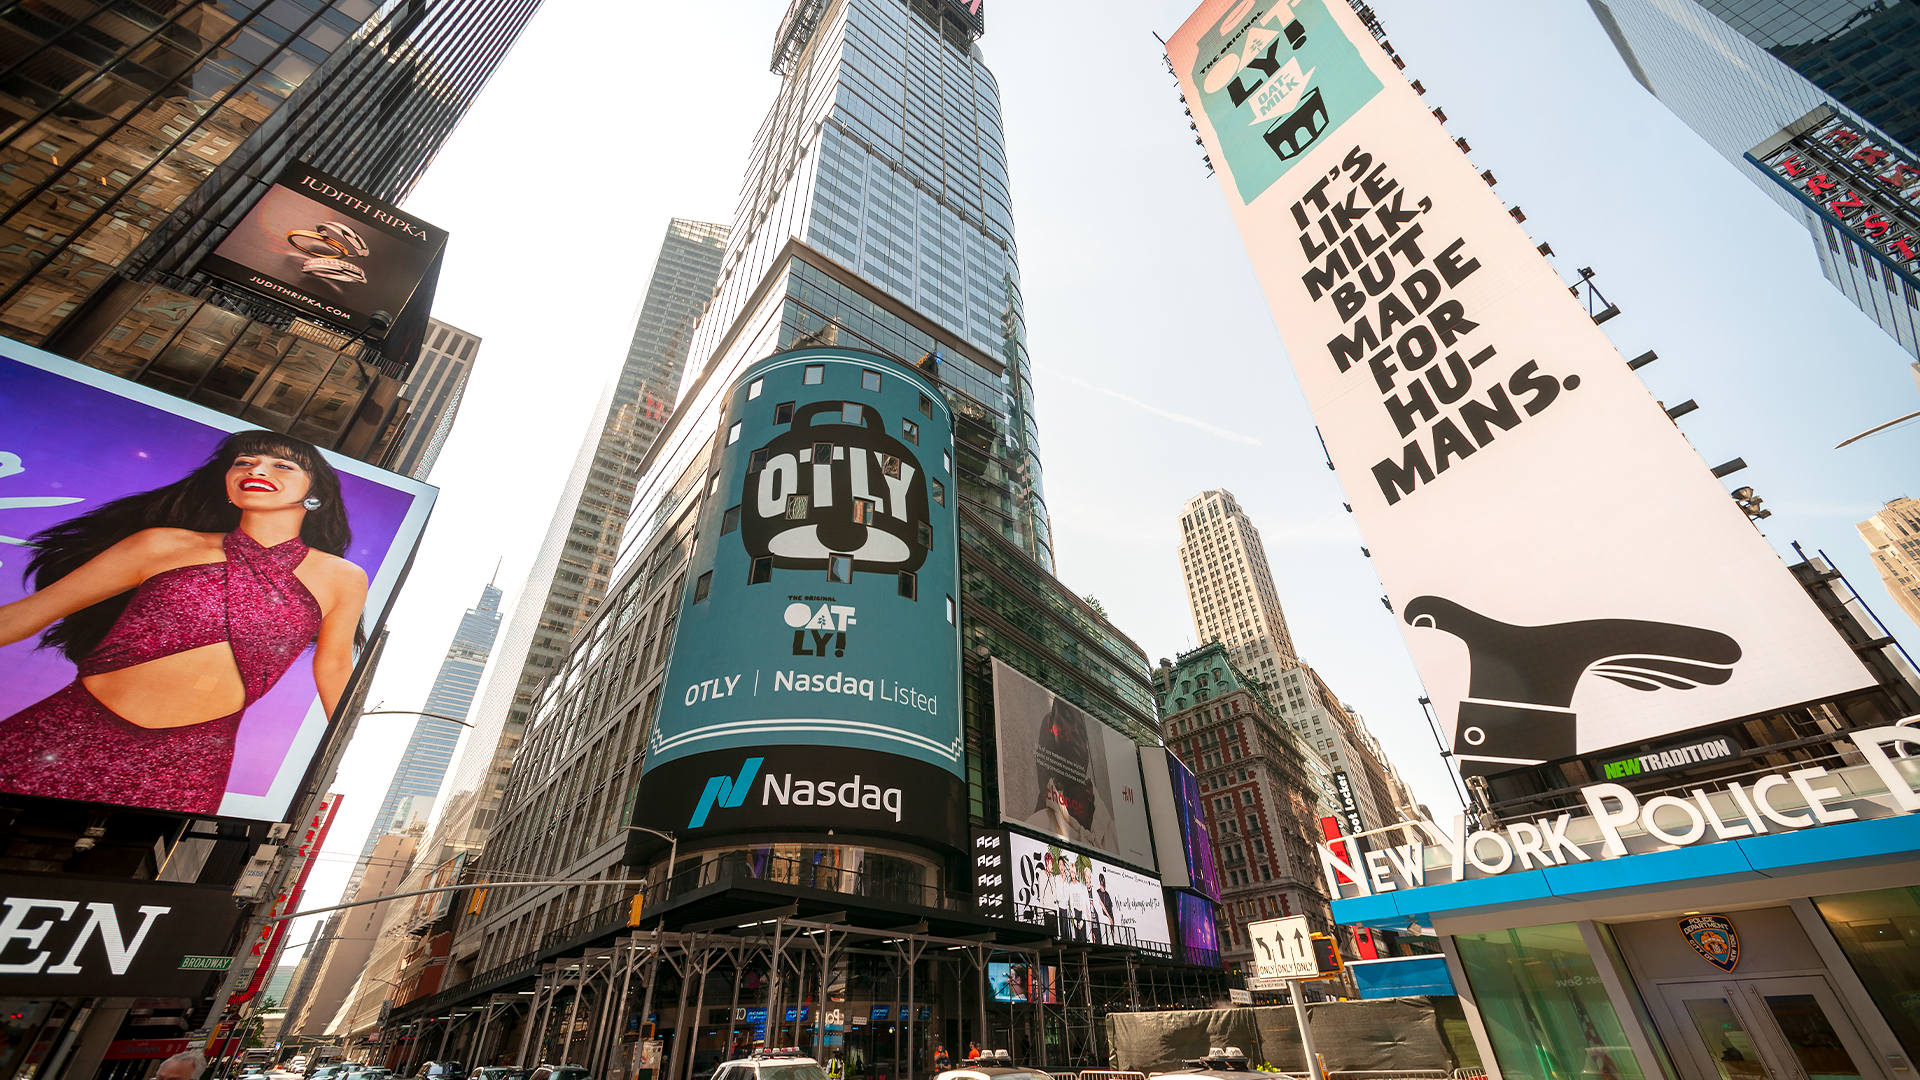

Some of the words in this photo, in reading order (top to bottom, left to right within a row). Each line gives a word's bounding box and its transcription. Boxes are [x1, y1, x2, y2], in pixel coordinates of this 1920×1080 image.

[1200, 55, 1219, 75] THE
[1220, 11, 1263, 54] ORIGINAL
[1227, 19, 1307, 108] LY!
[1257, 73, 1290, 106] OAT-
[1259, 76, 1300, 117] MILK
[301, 175, 372, 214] JUDITH
[373, 208, 427, 242] RIPKA
[1290, 145, 1373, 231] IT'S
[1782, 155, 1915, 260] ERNST
[1299, 162, 1399, 263] LIKE
[1301, 187, 1433, 302] MILK,
[1330, 222, 1425, 324] BUT
[249, 275, 350, 320] JUDITHRIPKA.COM
[1326, 236, 1482, 374] MADE
[1368, 299, 1481, 395] FOR
[1383, 344, 1497, 439] HU-
[1370, 358, 1581, 507] MANS.
[758, 446, 915, 523] OTLY
[792, 629, 847, 658] LY!
[684, 673, 742, 706] OTLY
[774, 670, 874, 701] Nasdaq
[880, 678, 937, 716] Listed
[762, 773, 901, 823] Nasdaq
[1045, 785, 1084, 816] change
[1336, 773, 1355, 812] Locker
[977, 835, 1000, 848] ACE
[977, 854, 1001, 868] ACE
[978, 873, 1002, 887] ACE
[0, 897, 171, 975] EN
[1683, 922, 1729, 935] DEPARTMENT
[1688, 916, 1714, 925] POLICE
[181, 958, 230, 969] BROADWAY
[1260, 965, 1275, 975] ONLY
[1277, 963, 1293, 974] ONLY
[1296, 961, 1313, 972] ONLY
[1690, 940, 1705, 953] CITY
[1704, 953, 1714, 961] OF
